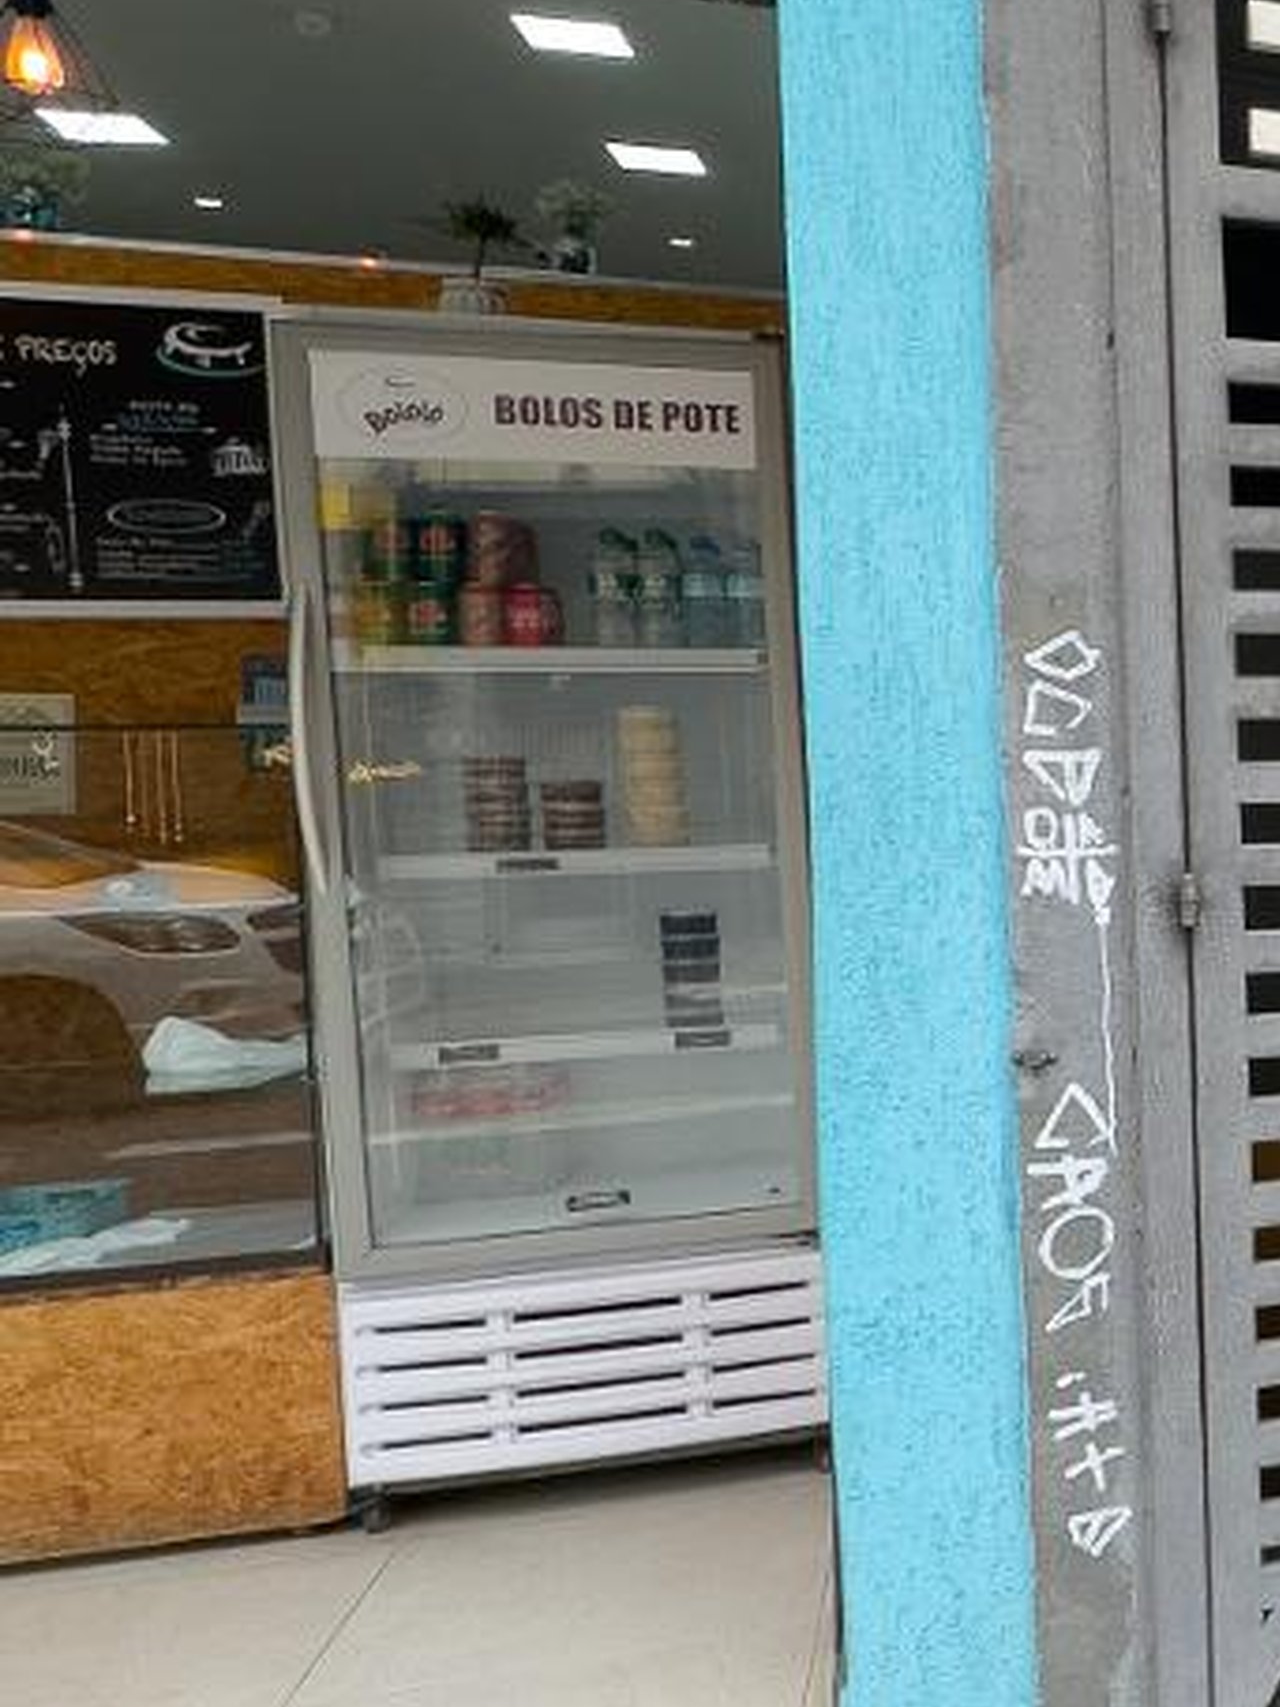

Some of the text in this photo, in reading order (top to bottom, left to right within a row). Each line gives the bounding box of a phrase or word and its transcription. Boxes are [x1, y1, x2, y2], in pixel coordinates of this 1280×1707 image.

[14, 333, 118, 379] PREÇOS
[494, 394, 741, 435] BOLOS DE POTE
